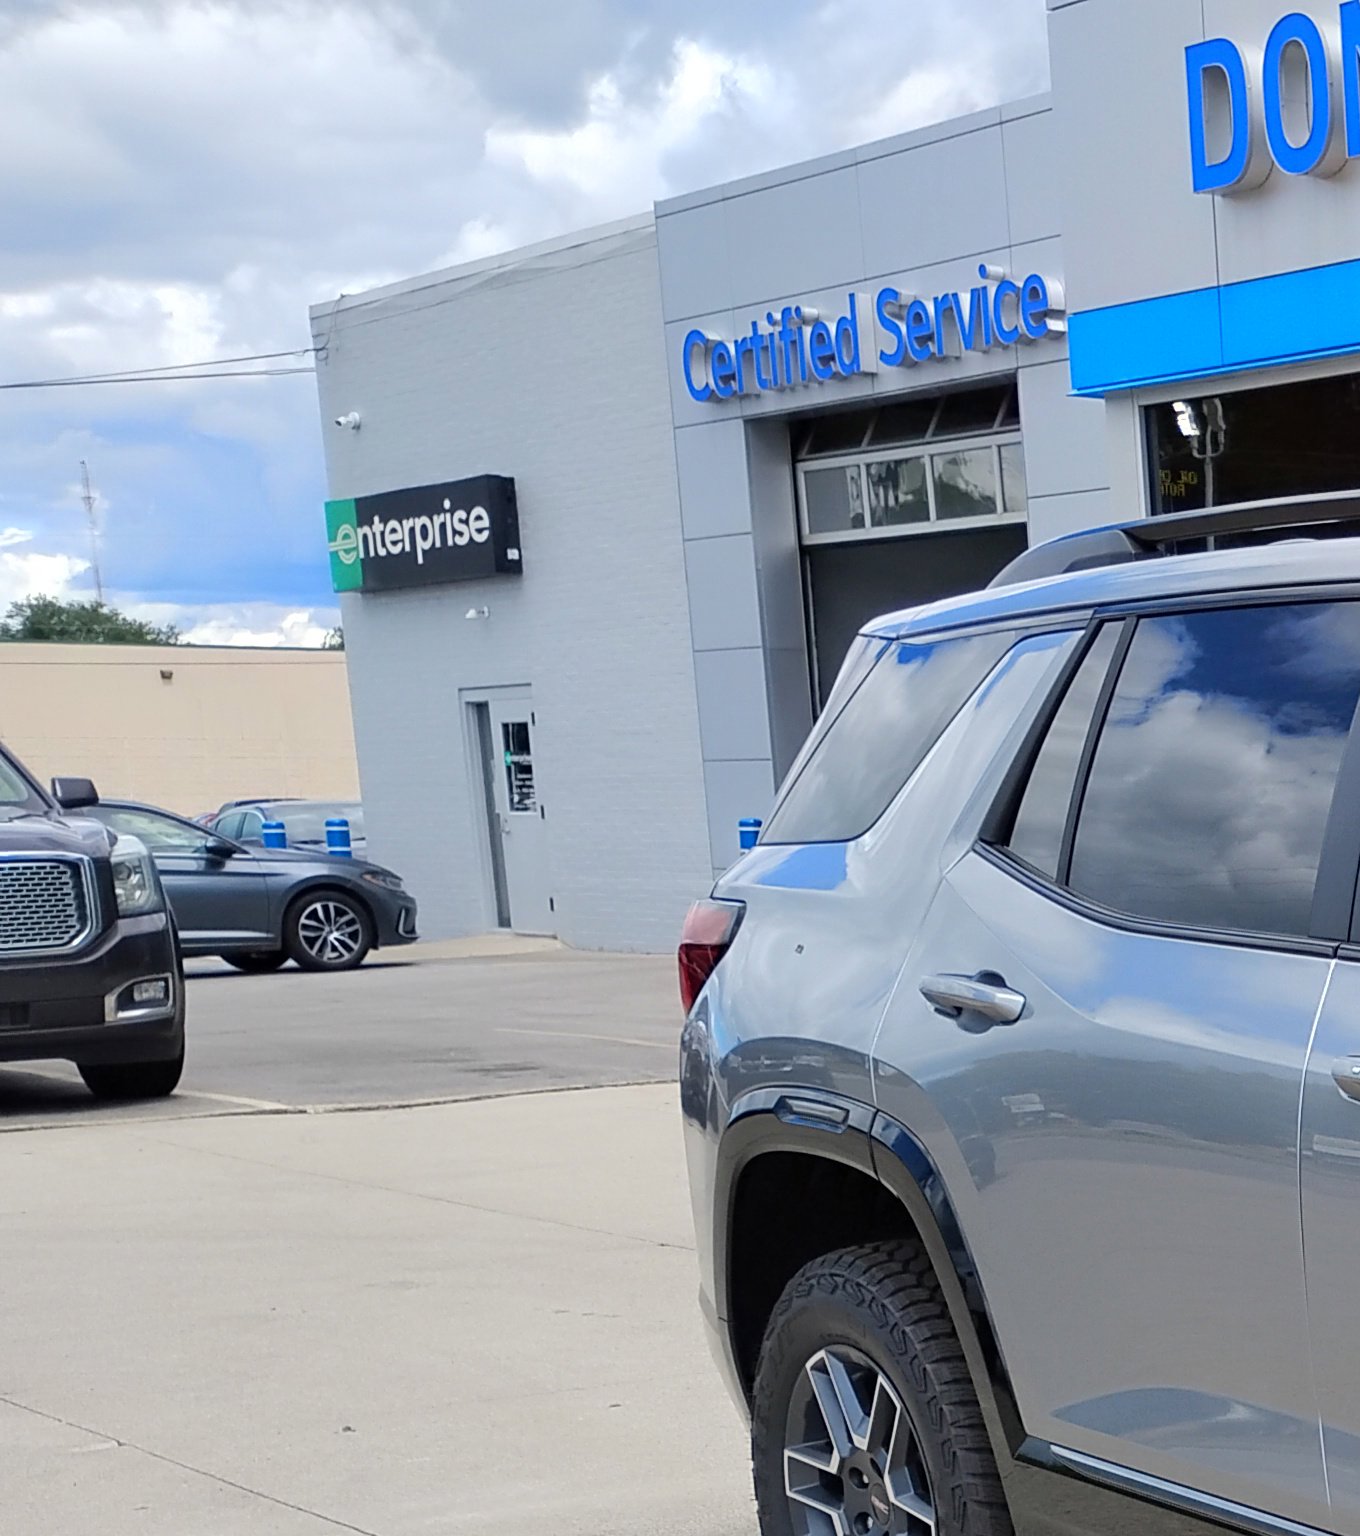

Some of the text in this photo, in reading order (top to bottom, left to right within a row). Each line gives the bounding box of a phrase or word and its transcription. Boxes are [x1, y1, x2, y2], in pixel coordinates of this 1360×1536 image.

[683, 263, 1049, 402] Certified Service
[328, 498, 490, 565] enterprise
